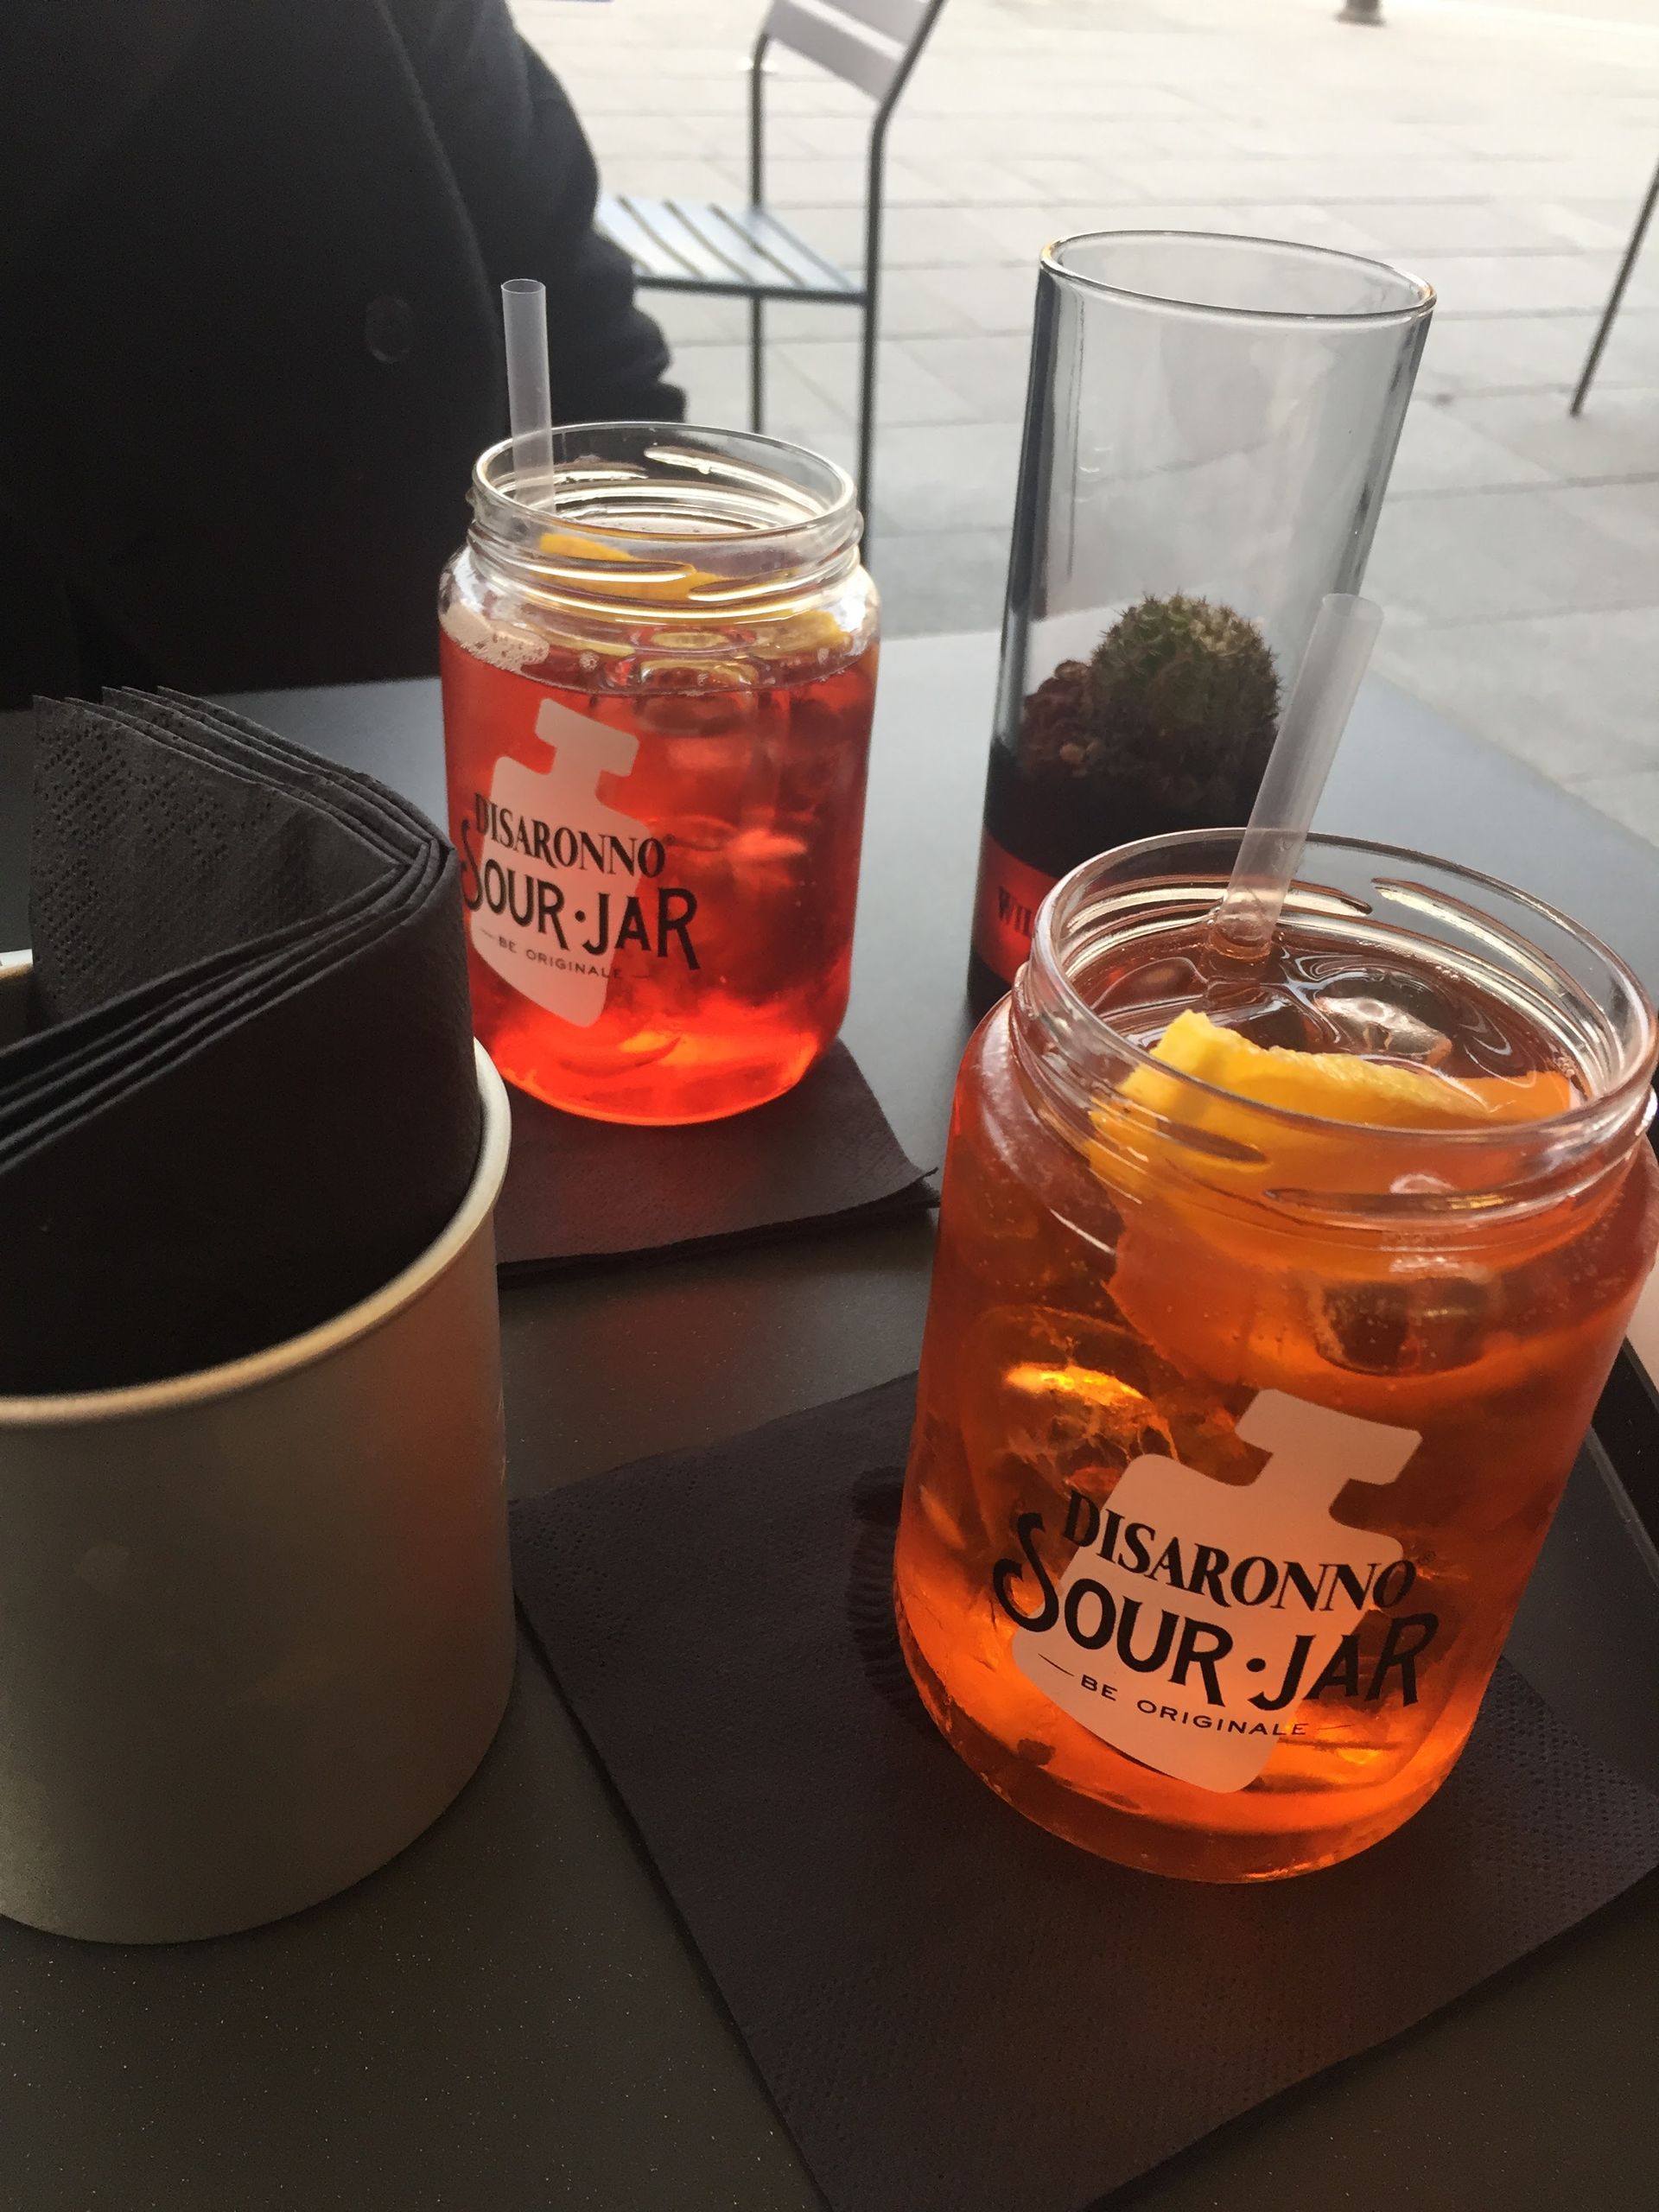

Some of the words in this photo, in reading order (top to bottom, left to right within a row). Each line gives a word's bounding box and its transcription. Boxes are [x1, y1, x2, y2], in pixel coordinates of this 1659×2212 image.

[474, 791, 665, 878] DISARONNO
[499, 937, 517, 955] BE
[525, 948, 622, 979] ORIGINALE
[1063, 1491, 1417, 1611] DISARONNO
[1081, 1674, 1118, 1701] BE
[1137, 1700, 1307, 1736] ORIGINALE
